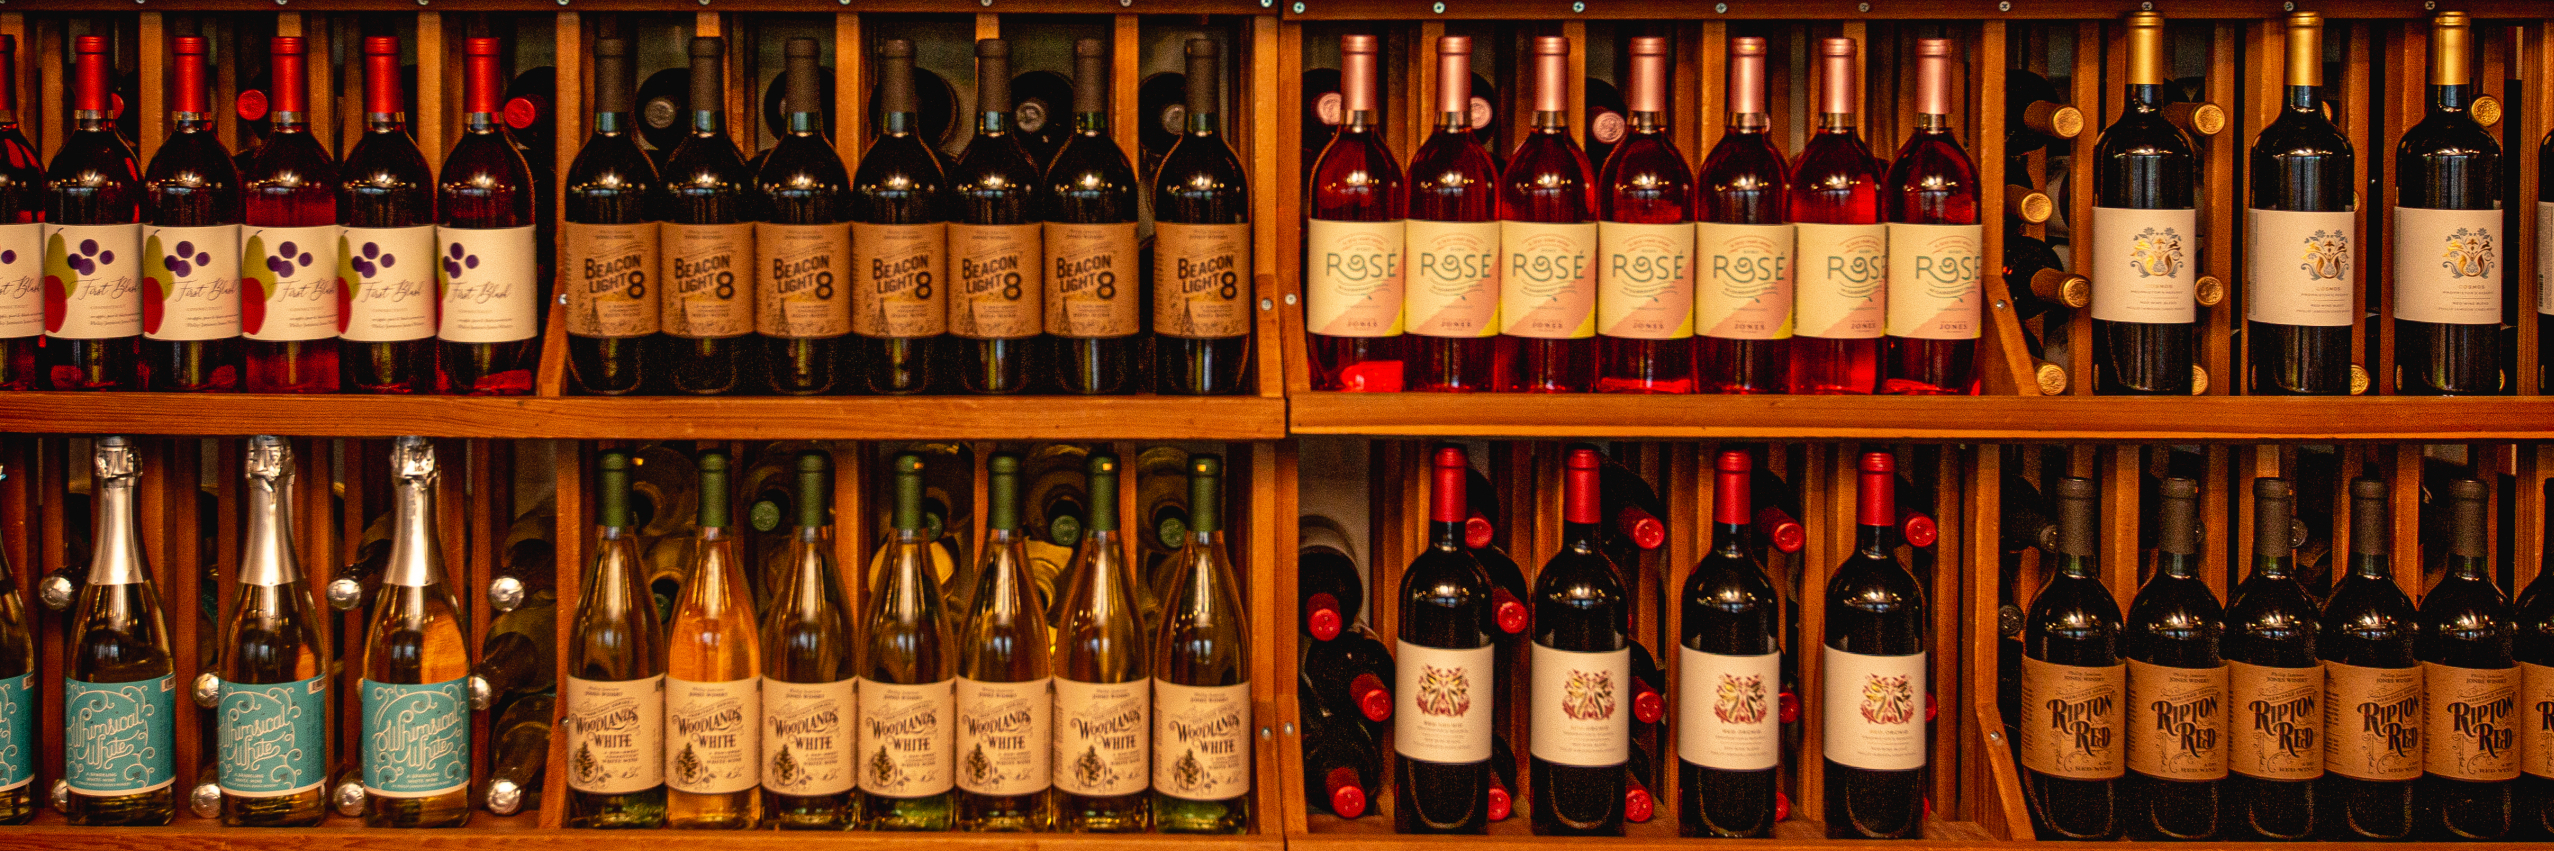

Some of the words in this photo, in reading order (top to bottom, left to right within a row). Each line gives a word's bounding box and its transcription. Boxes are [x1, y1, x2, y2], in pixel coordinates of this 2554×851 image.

[585, 254, 641, 279] BEACON
[674, 254, 730, 279] BEACON
[773, 255, 830, 280] BEACON
[873, 255, 928, 280] BEACON
[962, 255, 1018, 280] BEACON
[1056, 254, 1111, 279] BEACON
[1178, 254, 1234, 279] BEACON
[71, 278, 110, 300] First
[168, 280, 208, 302] First
[272, 280, 311, 302] First
[357, 281, 393, 302] First
[449, 281, 478, 302] First
[589, 273, 627, 293] LIGHT
[628, 270, 645, 299] 8
[678, 273, 714, 293] LIGHT
[716, 271, 734, 299] 8
[778, 273, 814, 293] LIGHT
[815, 271, 833, 300] 8
[877, 273, 914, 294] LIGHT
[915, 271, 932, 300] 8
[966, 274, 1003, 294] LIGHT
[1003, 272, 1022, 300] 8
[1060, 273, 1096, 293] LIGHT
[1096, 271, 1115, 300] 8
[1182, 272, 1219, 293] LIGHT
[1221, 271, 1237, 300] 8
[571, 707, 639, 735] WOODLANDS
[672, 706, 743, 737] WOODLANDS
[769, 708, 839, 737] WOODLANDS
[866, 709, 937, 739] WOODLANDS
[962, 708, 1032, 737] WOODLANDS
[1070, 707, 1141, 739] WOODLANDS
[1169, 711, 1240, 742] WOODLANDS
[2046, 693, 2113, 735] RIPTON
[2151, 696, 2218, 736] RIPTON
[2249, 695, 2315, 736] RIPTON
[2357, 695, 2420, 738] RIPTON
[2447, 697, 2514, 737] RIPTON
[588, 732, 632, 748] WHITE
[691, 733, 736, 748] WHITE
[788, 735, 833, 750] WHITE
[886, 735, 931, 751] WHITE
[980, 734, 1026, 750] WHITE
[1094, 734, 1136, 750] WHITE
[1192, 739, 1234, 754] WHITE
[2070, 720, 2111, 756] RED
[2175, 722, 2216, 758] RED
[2273, 722, 2314, 758] RED
[2382, 722, 2418, 758] RED
[2473, 723, 2512, 758] RED
